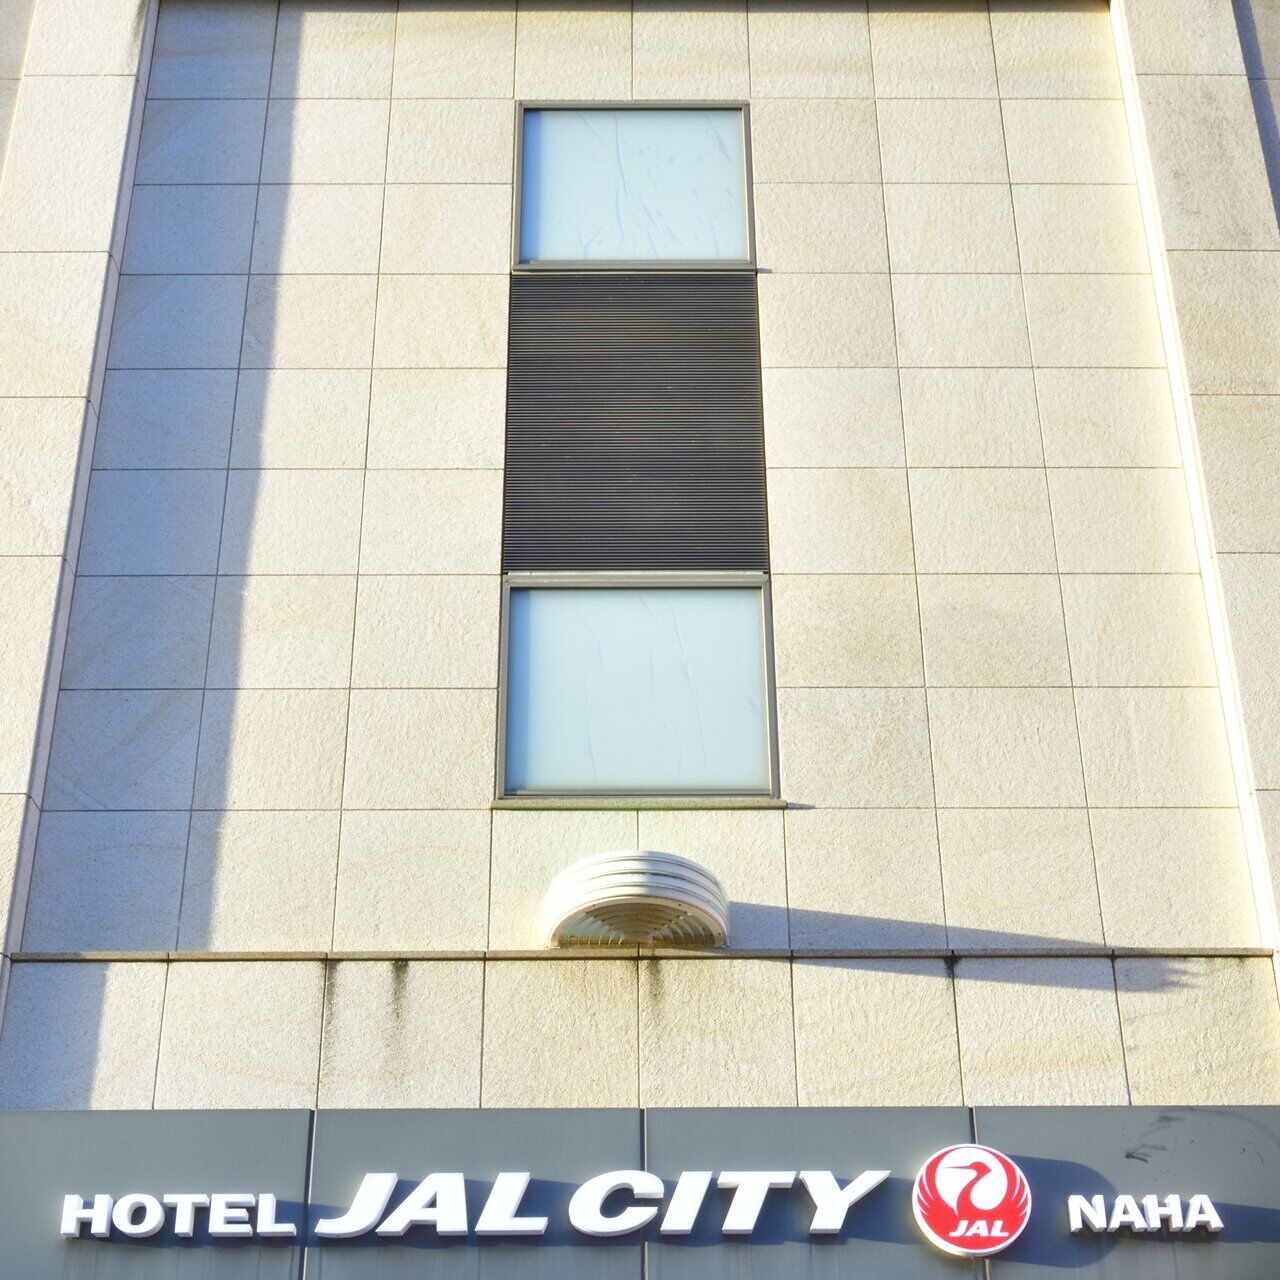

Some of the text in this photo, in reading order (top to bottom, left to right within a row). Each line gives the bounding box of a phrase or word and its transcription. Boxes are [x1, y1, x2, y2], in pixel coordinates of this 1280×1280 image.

[60, 1169, 892, 1239] HOTEL JAL CITY
[1067, 1194, 1225, 1234] NAHA
[948, 1219, 1010, 1238] JAL
